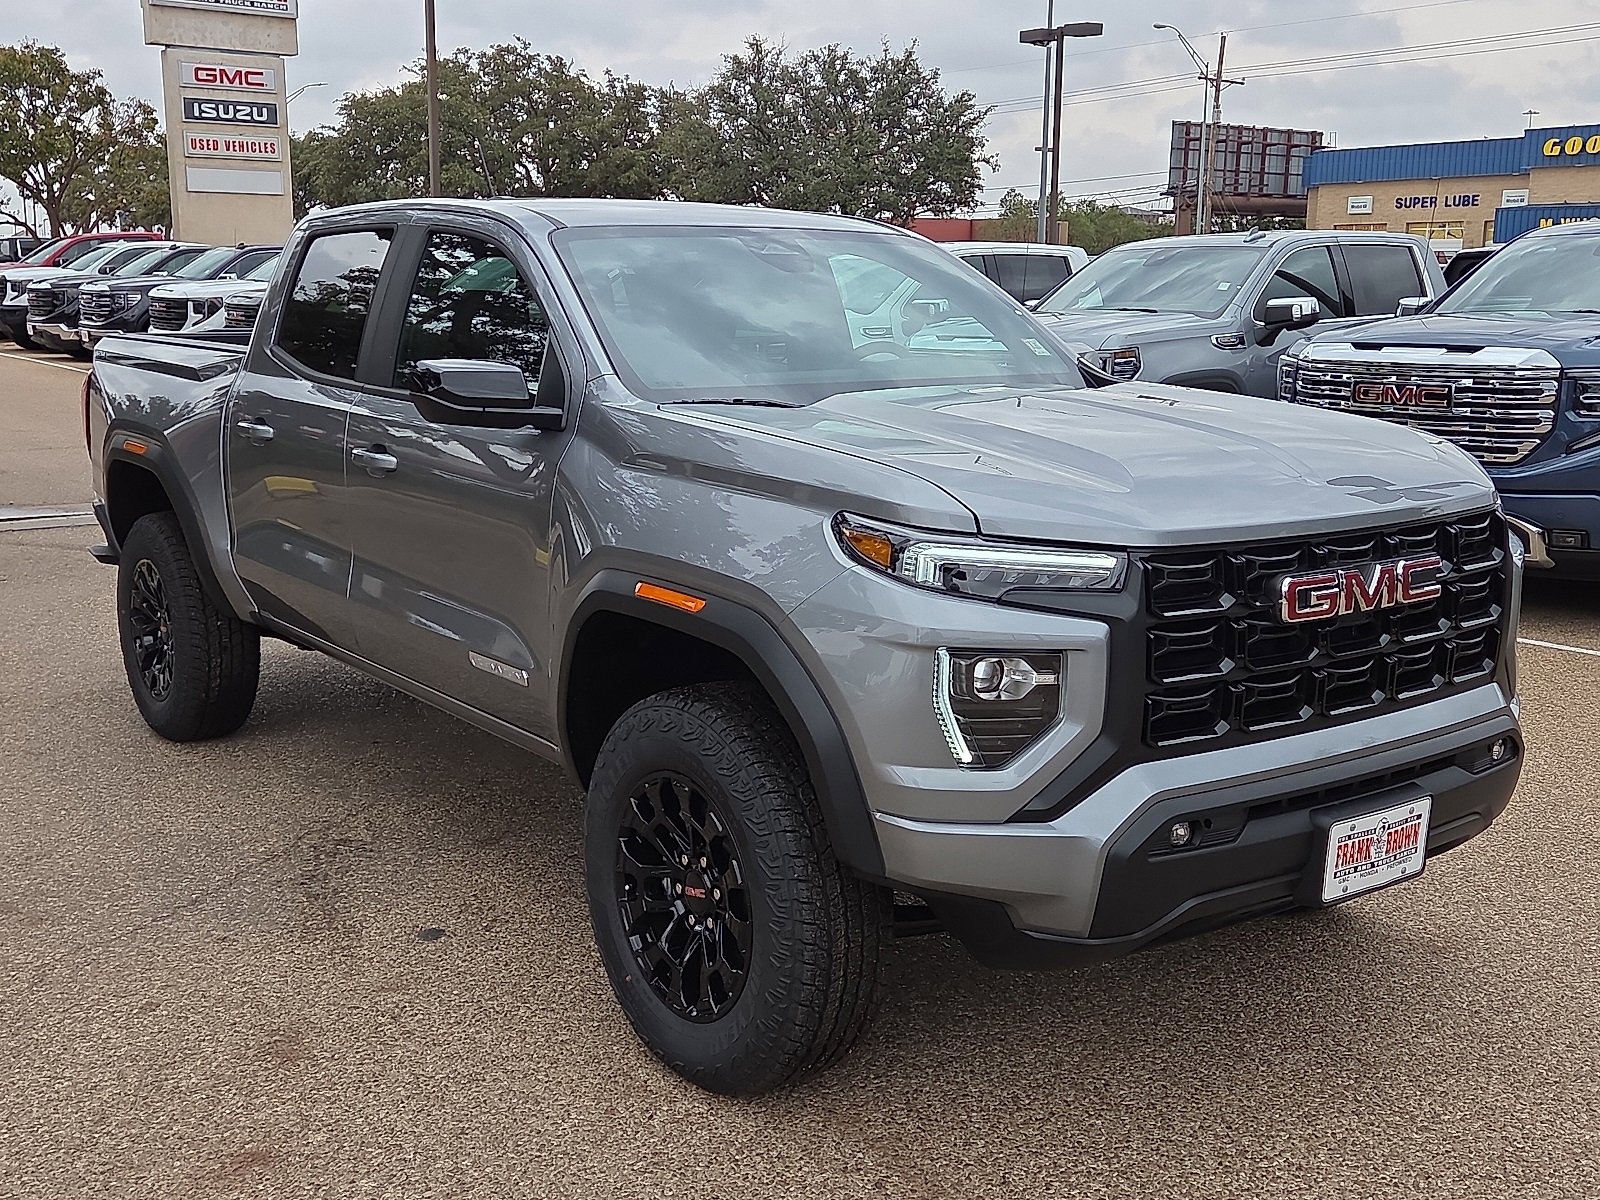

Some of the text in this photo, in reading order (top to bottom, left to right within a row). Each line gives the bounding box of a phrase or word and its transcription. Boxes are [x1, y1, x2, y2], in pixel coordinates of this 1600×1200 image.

[254, 2, 286, 10] RANCH
[194, 67, 265, 87] GMC
[193, 102, 268, 121] ISUZU
[190, 138, 276, 154] USED VEHICLES
[1395, 194, 1480, 209] SUPER LUBE
[1356, 384, 1448, 406] GMC
[1282, 556, 1441, 623] GMC
[1335, 822, 1421, 870] FRANK BROWN
[1336, 848, 1416, 878] AUTO AND TRUCK RANCH
